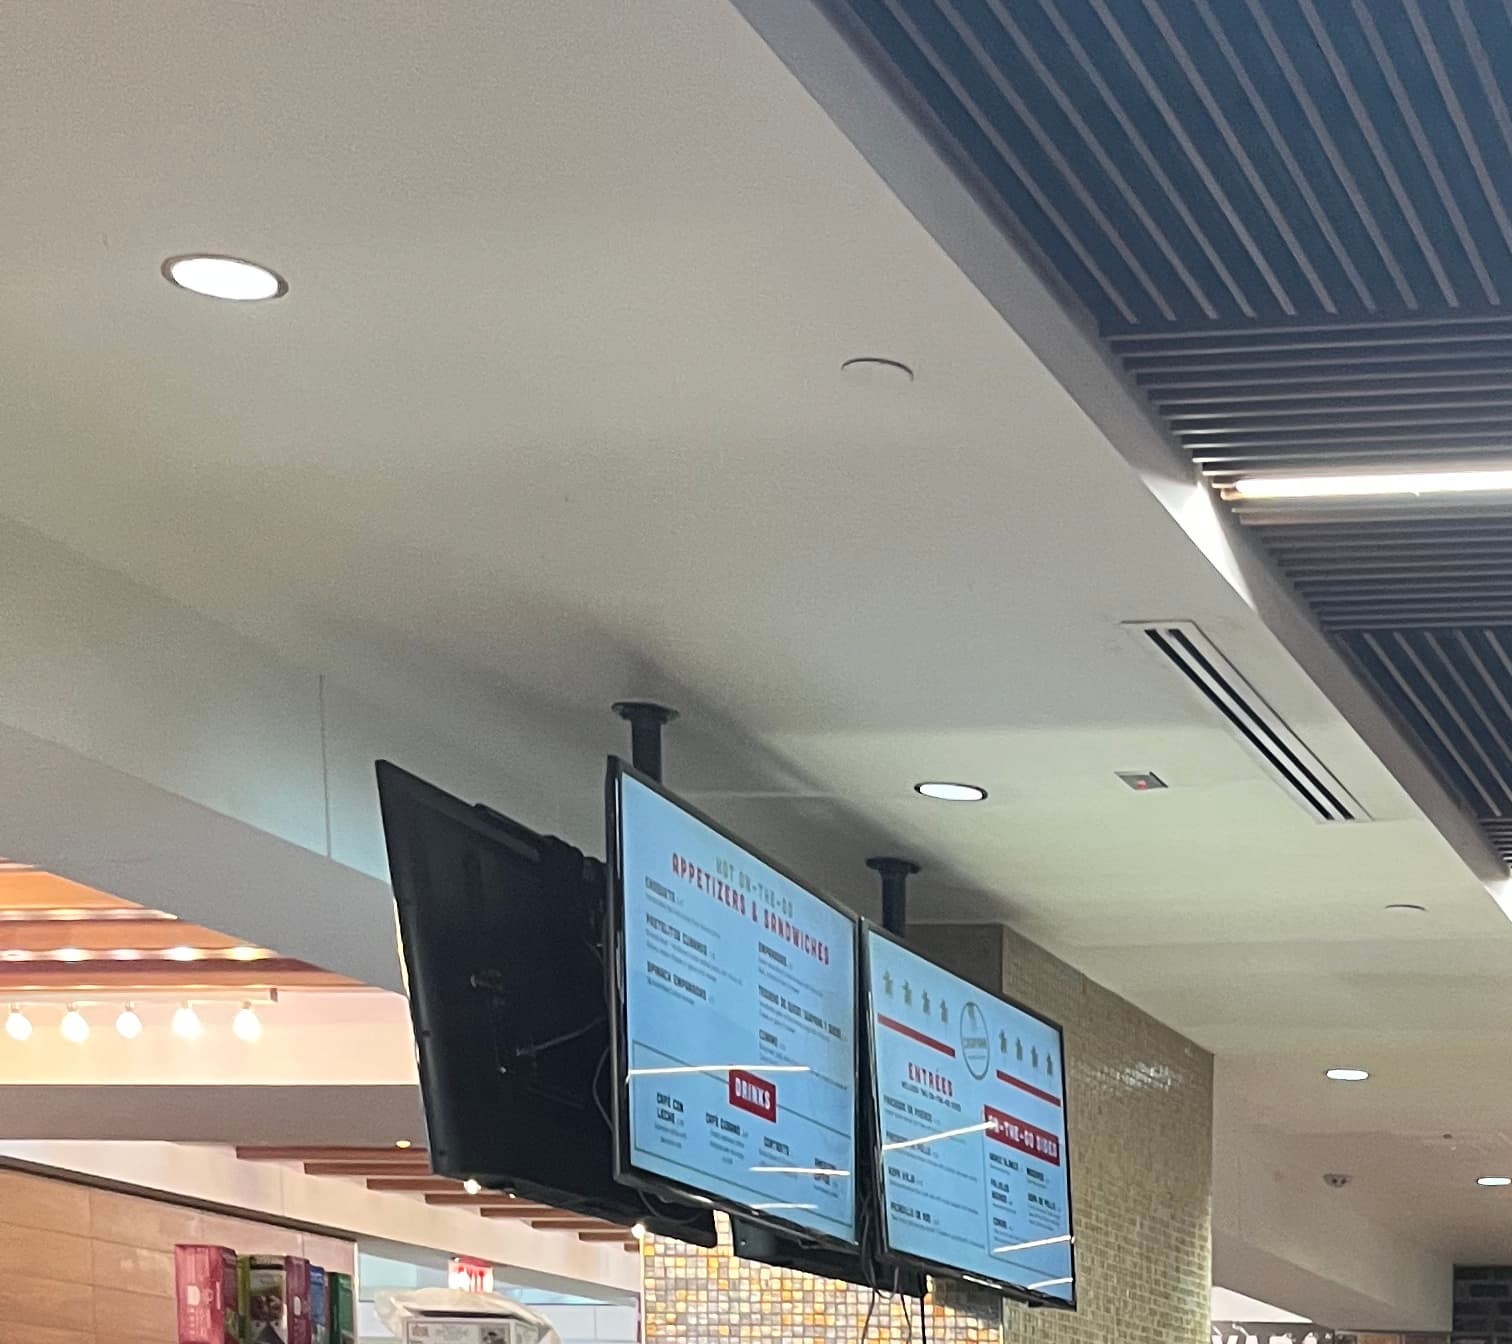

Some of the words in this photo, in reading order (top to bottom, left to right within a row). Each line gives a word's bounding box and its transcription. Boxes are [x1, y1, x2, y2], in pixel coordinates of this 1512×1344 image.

[672, 852, 745, 915] APPETIZERS
[764, 908, 829, 966] SANDWICHES
[735, 1077, 771, 1111] DRINKS
